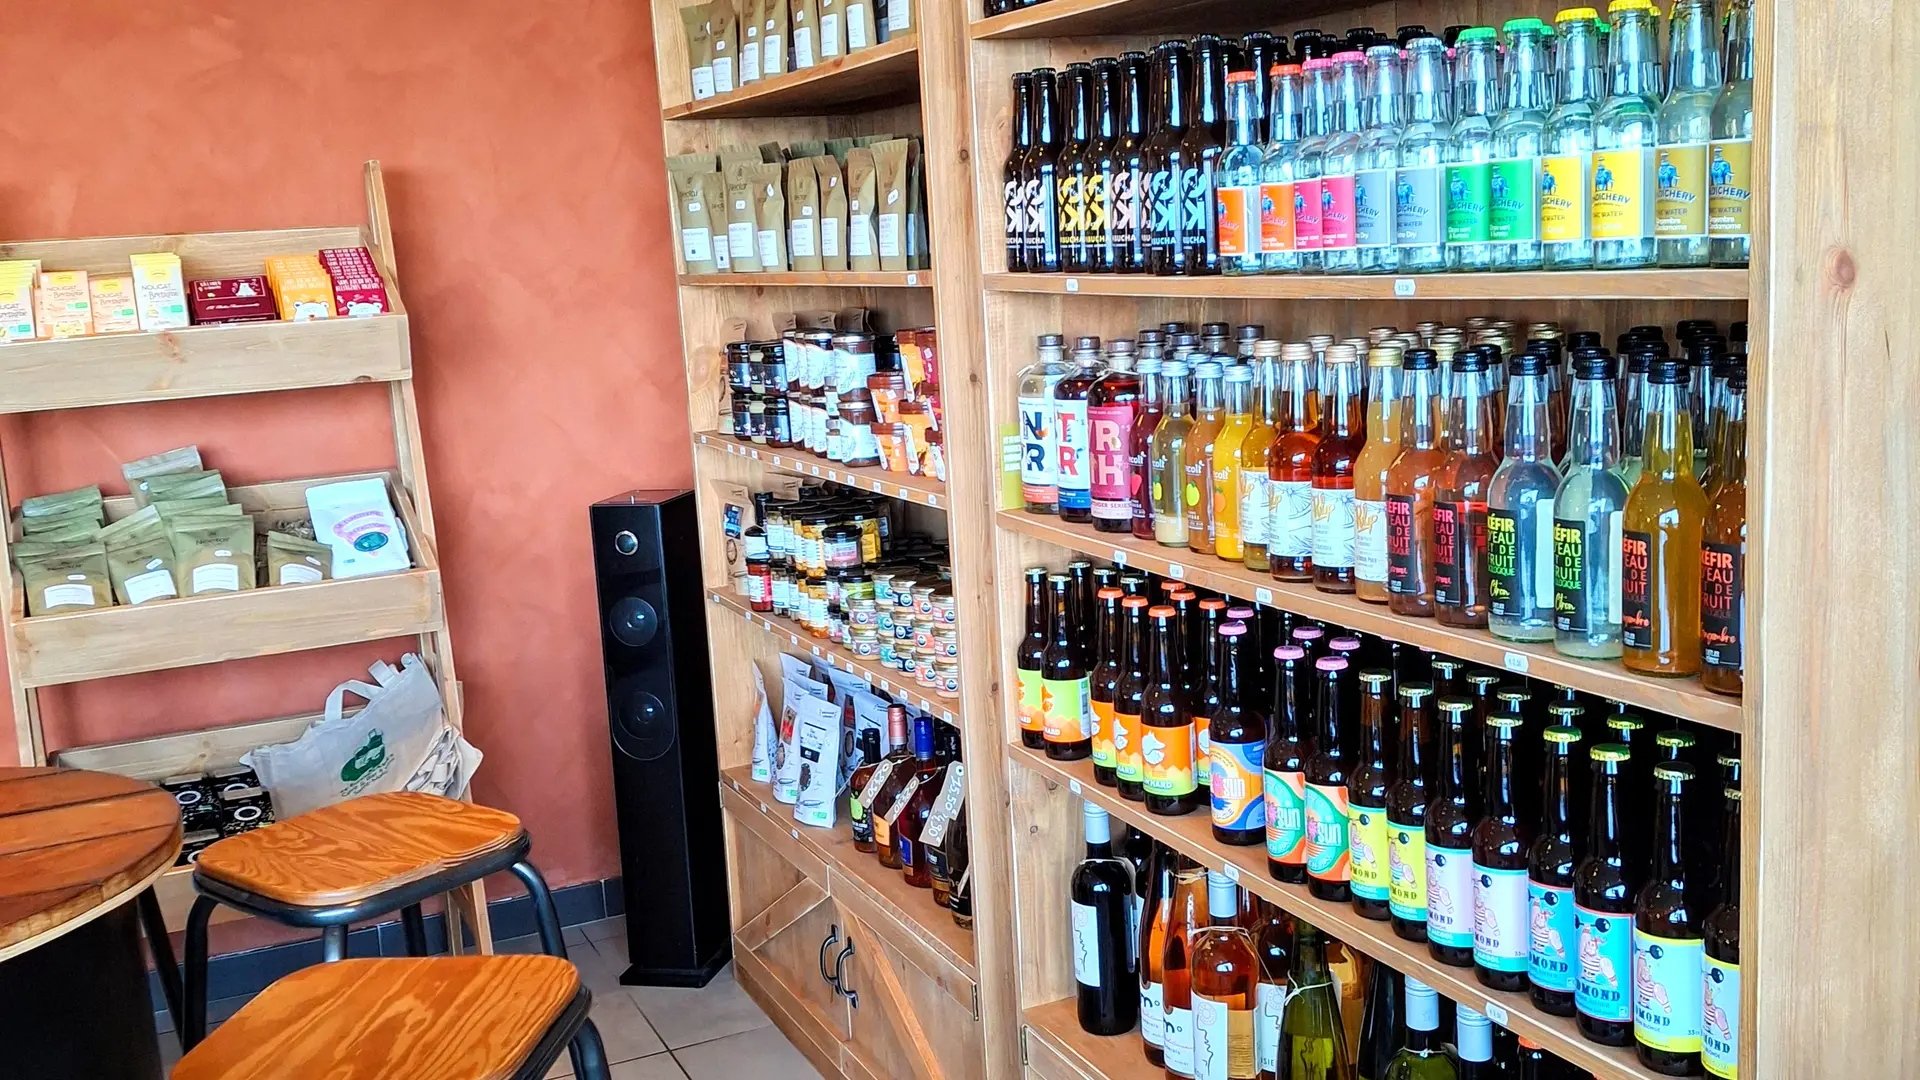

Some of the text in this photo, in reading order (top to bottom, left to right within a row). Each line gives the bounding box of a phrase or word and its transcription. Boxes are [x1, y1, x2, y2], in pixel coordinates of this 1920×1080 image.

[1593, 191, 1631, 205] DICHERY
[1656, 187, 1697, 203] DICHERY
[1387, 498, 1410, 515] ÉFIR
[1390, 515, 1410, 527] EAU
[1433, 505, 1454, 523] ÉFIR
[1436, 523, 1454, 535] EAU
[1555, 523, 1581, 543] ÉFIR
[1500, 545, 1515, 555] DE
[1623, 534, 1648, 556] ÉFIR
[1565, 557, 1581, 568] DE
[1624, 555, 1648, 570] EAU
[1631, 570, 1647, 582] DE
[1624, 579, 1647, 596] UIT
[1715, 584, 1733, 597] DE
[1428, 911, 1453, 925] MOND
[1474, 931, 1499, 948] MOND
